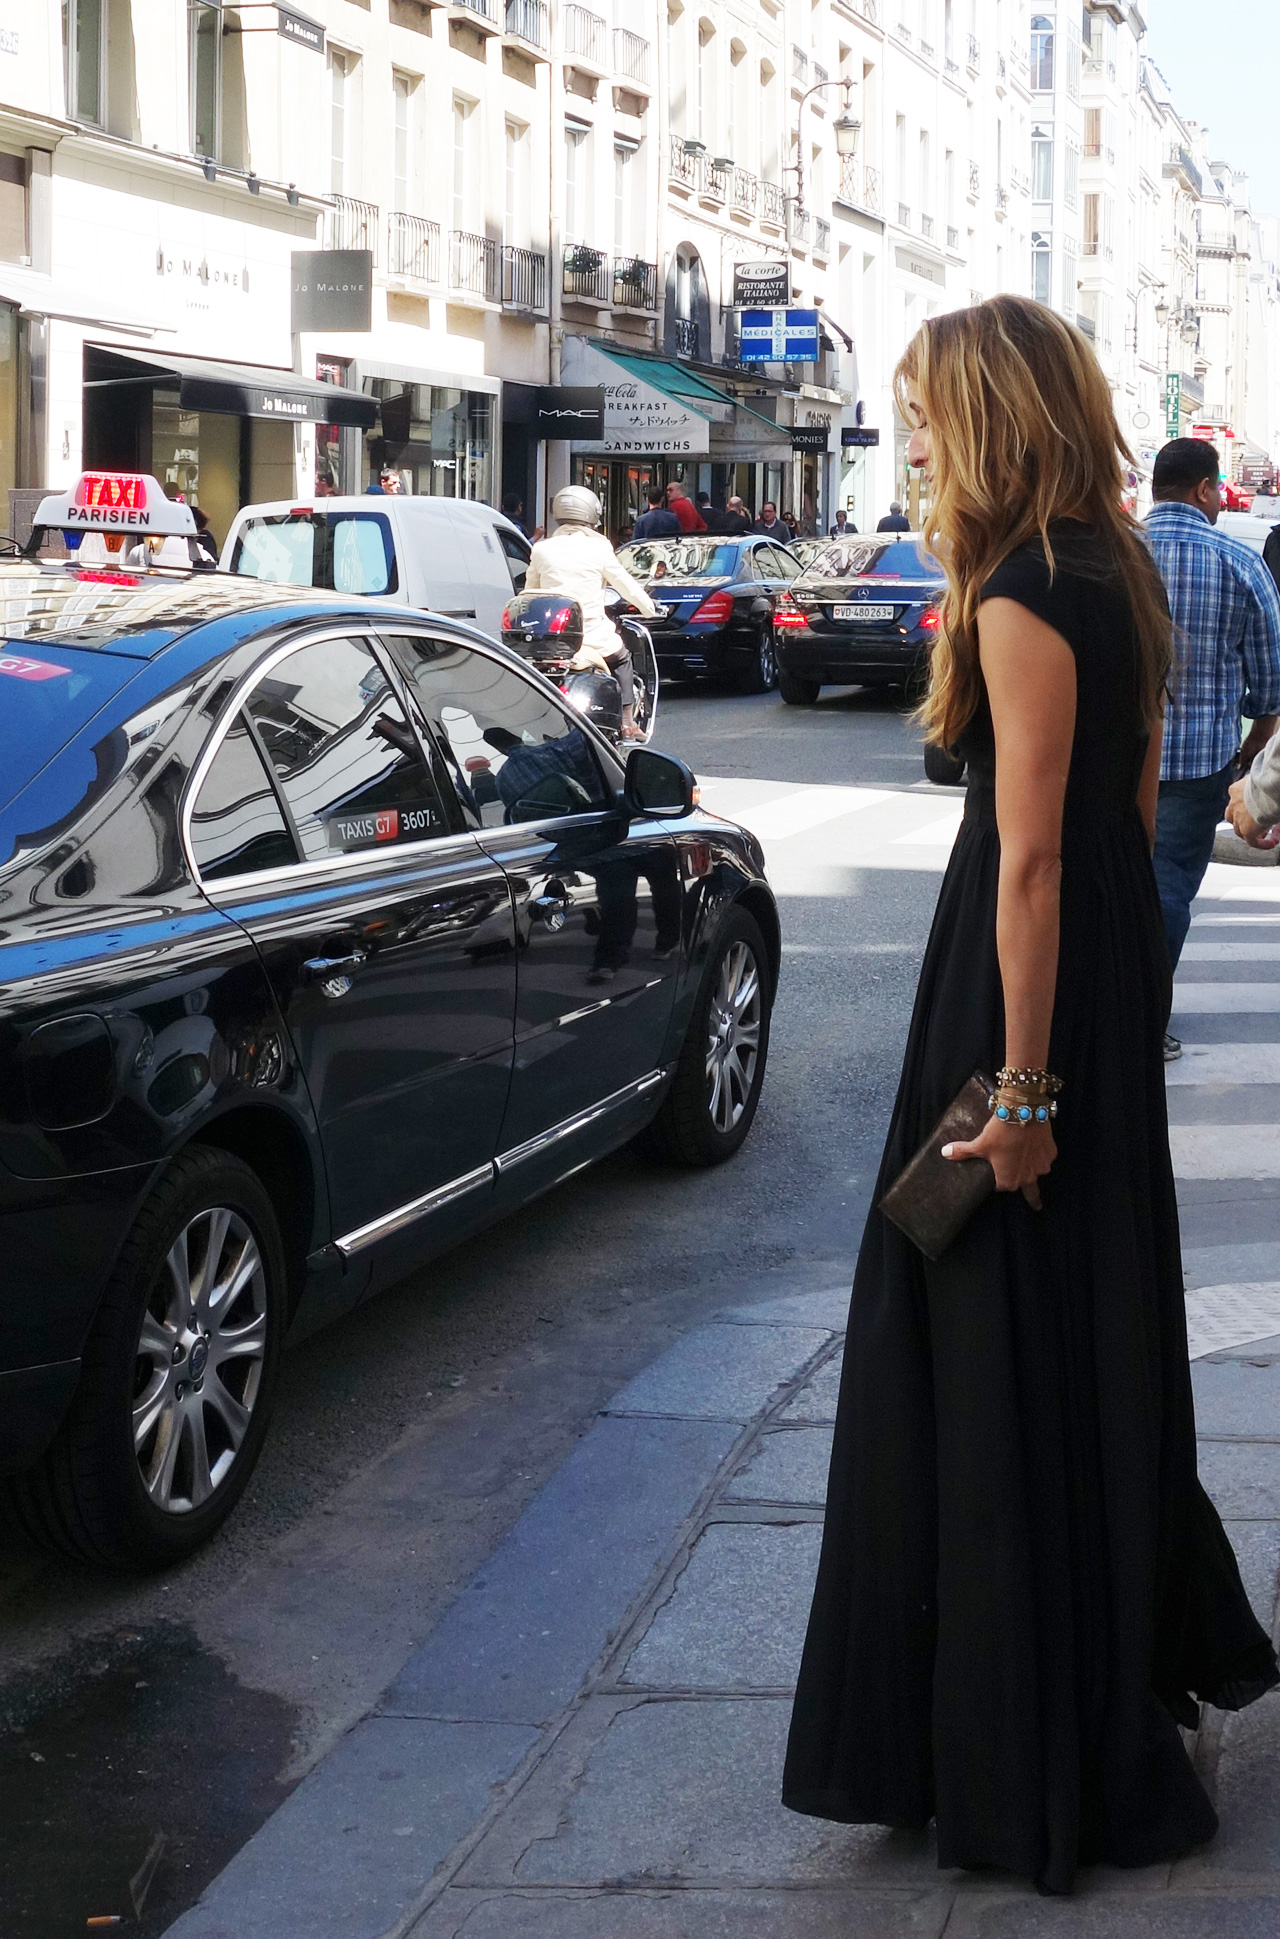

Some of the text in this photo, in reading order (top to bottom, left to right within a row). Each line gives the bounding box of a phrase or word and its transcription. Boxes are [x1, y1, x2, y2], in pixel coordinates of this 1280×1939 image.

[755, 266, 781, 275] corte
[737, 281, 786, 290] RISTORANTE
[743, 289, 780, 298] ITALIANO
[604, 402, 668, 411] REAKFAST
[538, 409, 600, 418] MAC
[604, 440, 691, 451] SANDWICHS
[433, 459, 456, 469] MAC
[83, 477, 141, 508] TAXI
[67, 507, 150, 525] PARISIEN
[337, 819, 375, 840] TAXIS
[375, 816, 390, 834] G7
[401, 809, 430, 831] 3607
